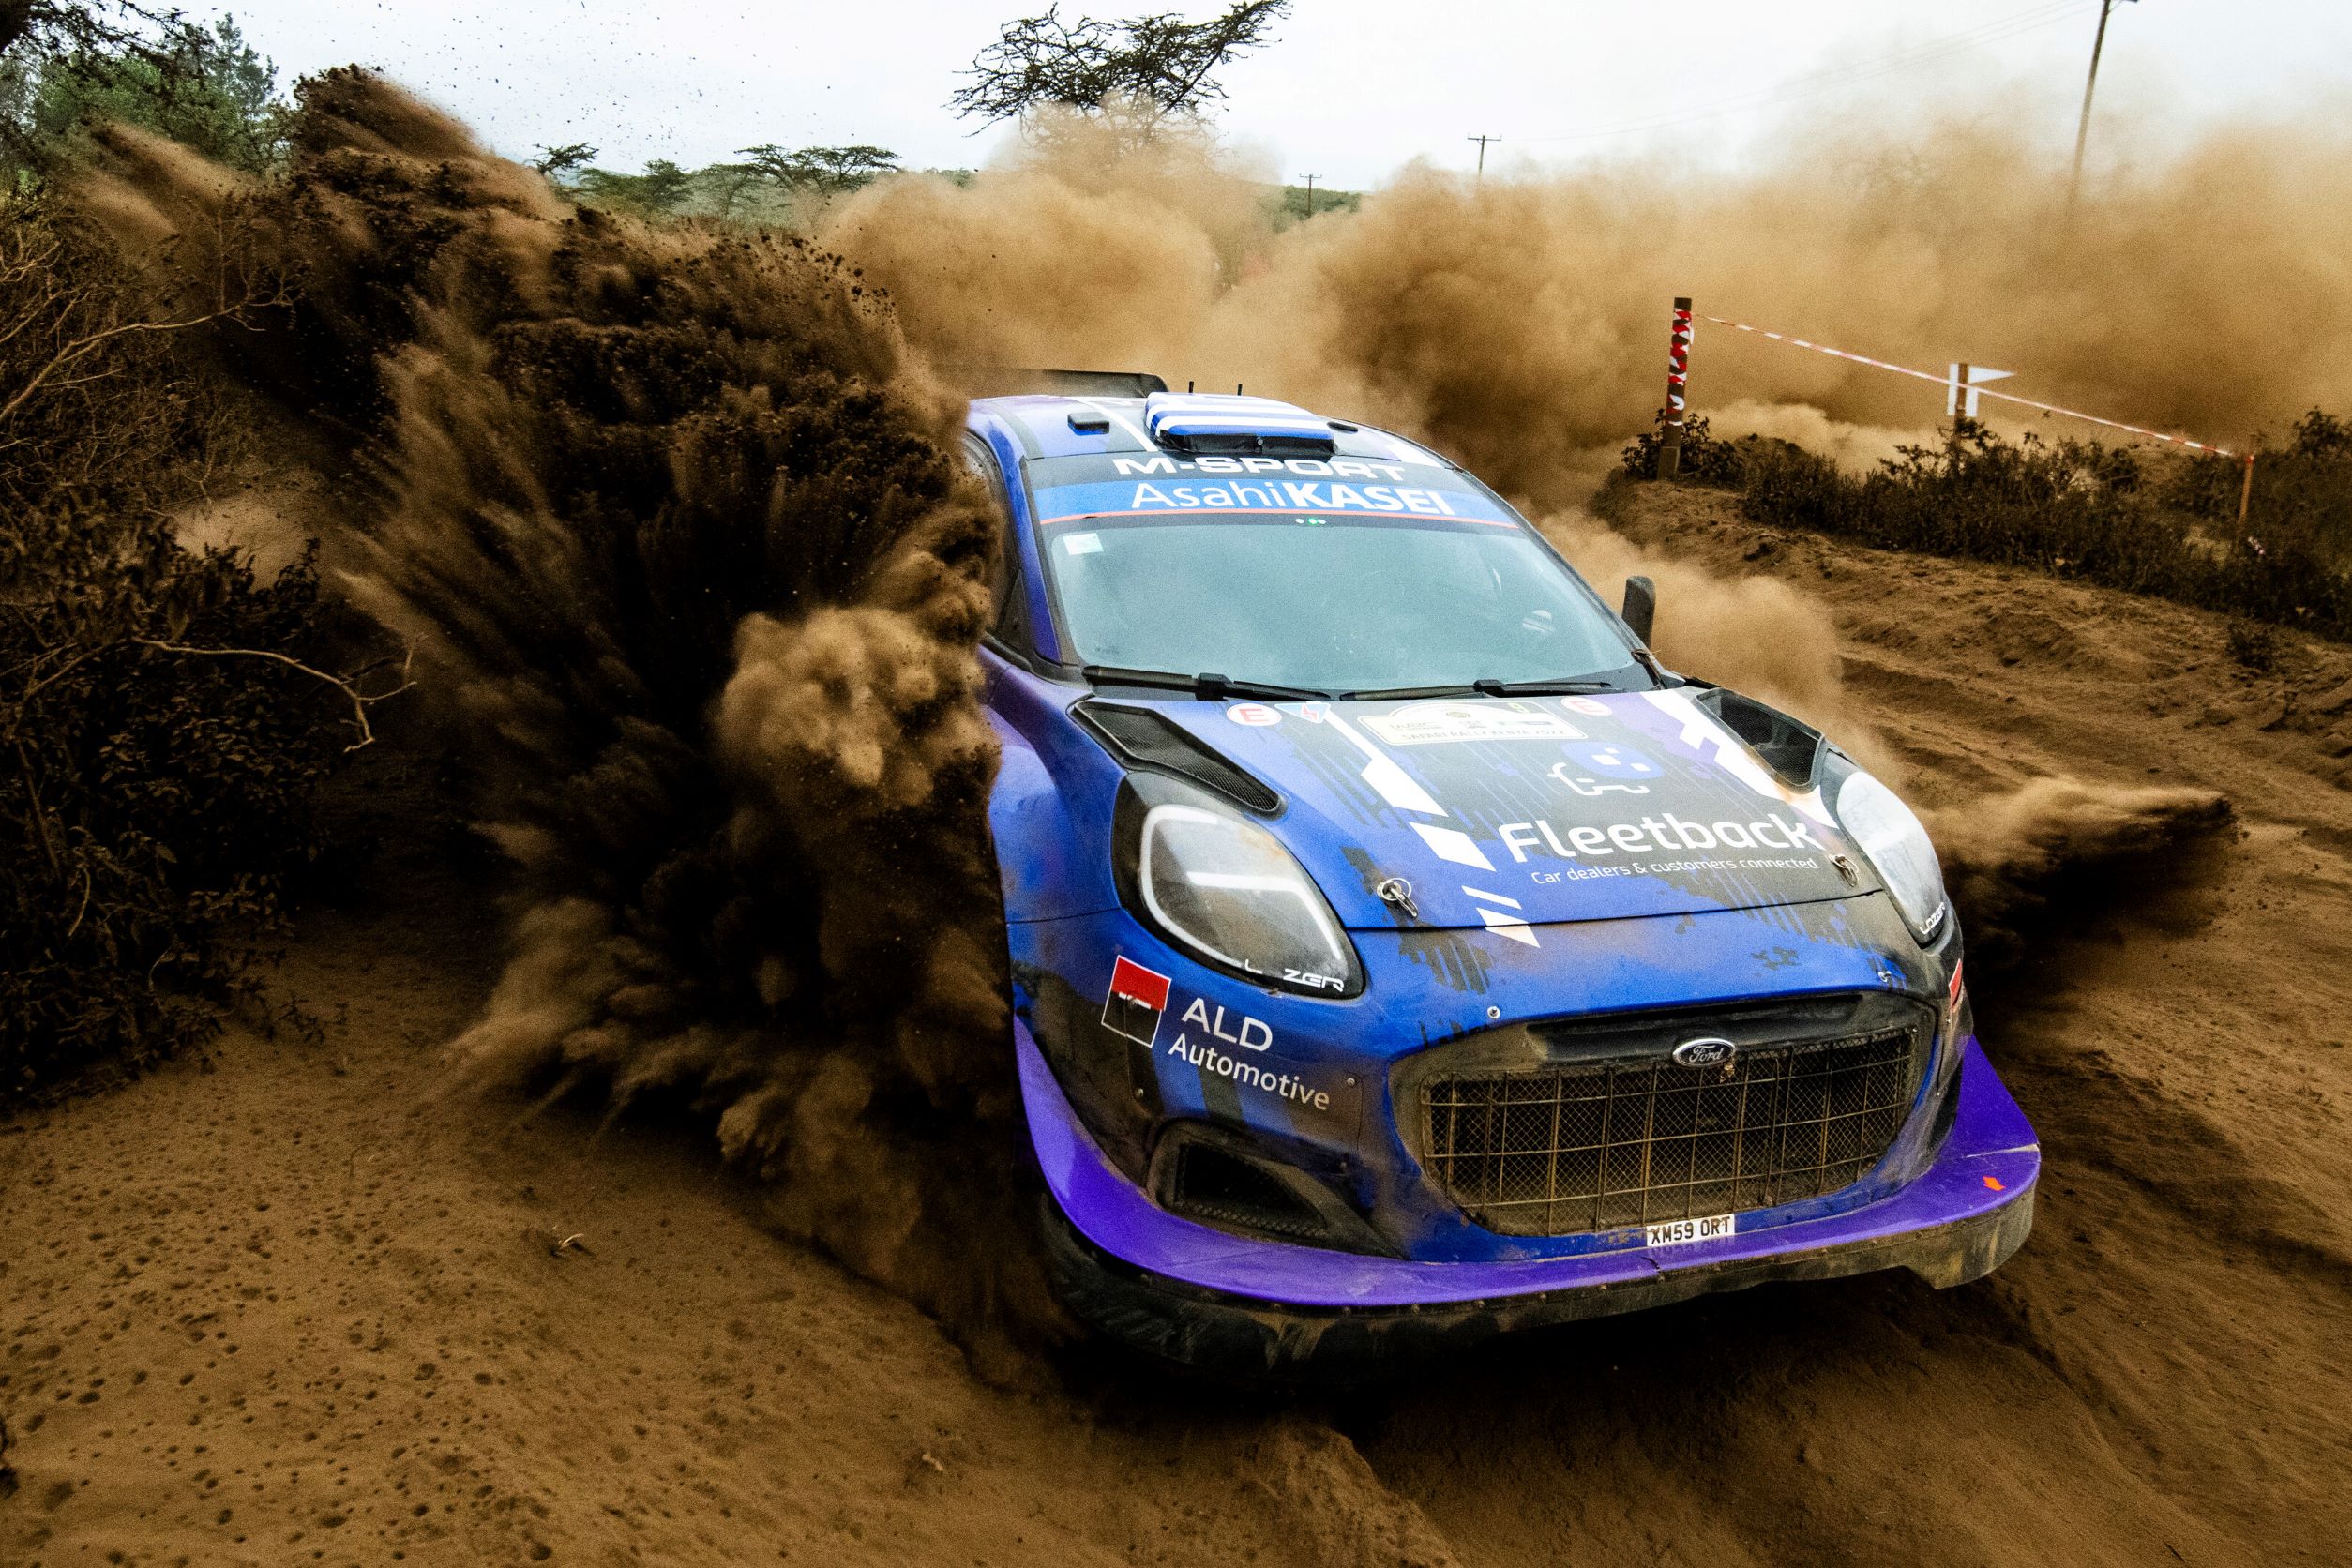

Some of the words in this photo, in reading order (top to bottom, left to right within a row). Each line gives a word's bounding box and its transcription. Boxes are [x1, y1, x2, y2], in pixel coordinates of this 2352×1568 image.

[1112, 457, 1405, 481] M-SPORT
[1131, 481, 1455, 515] AsahiKASEI
[1498, 812, 1827, 863] Fleetback
[1531, 869, 1561, 884] Car
[1567, 864, 1631, 882] dealers
[1635, 864, 1647, 875] &
[1650, 858, 1737, 873] customers
[1739, 856, 1819, 870] connected
[1181, 998, 1274, 1052] ALD
[1689, 1044, 1724, 1063] Ford
[1168, 1033, 1330, 1111] Automotive
[1651, 1221, 1694, 1244] XM59
[1700, 1216, 1731, 1237] ORT
